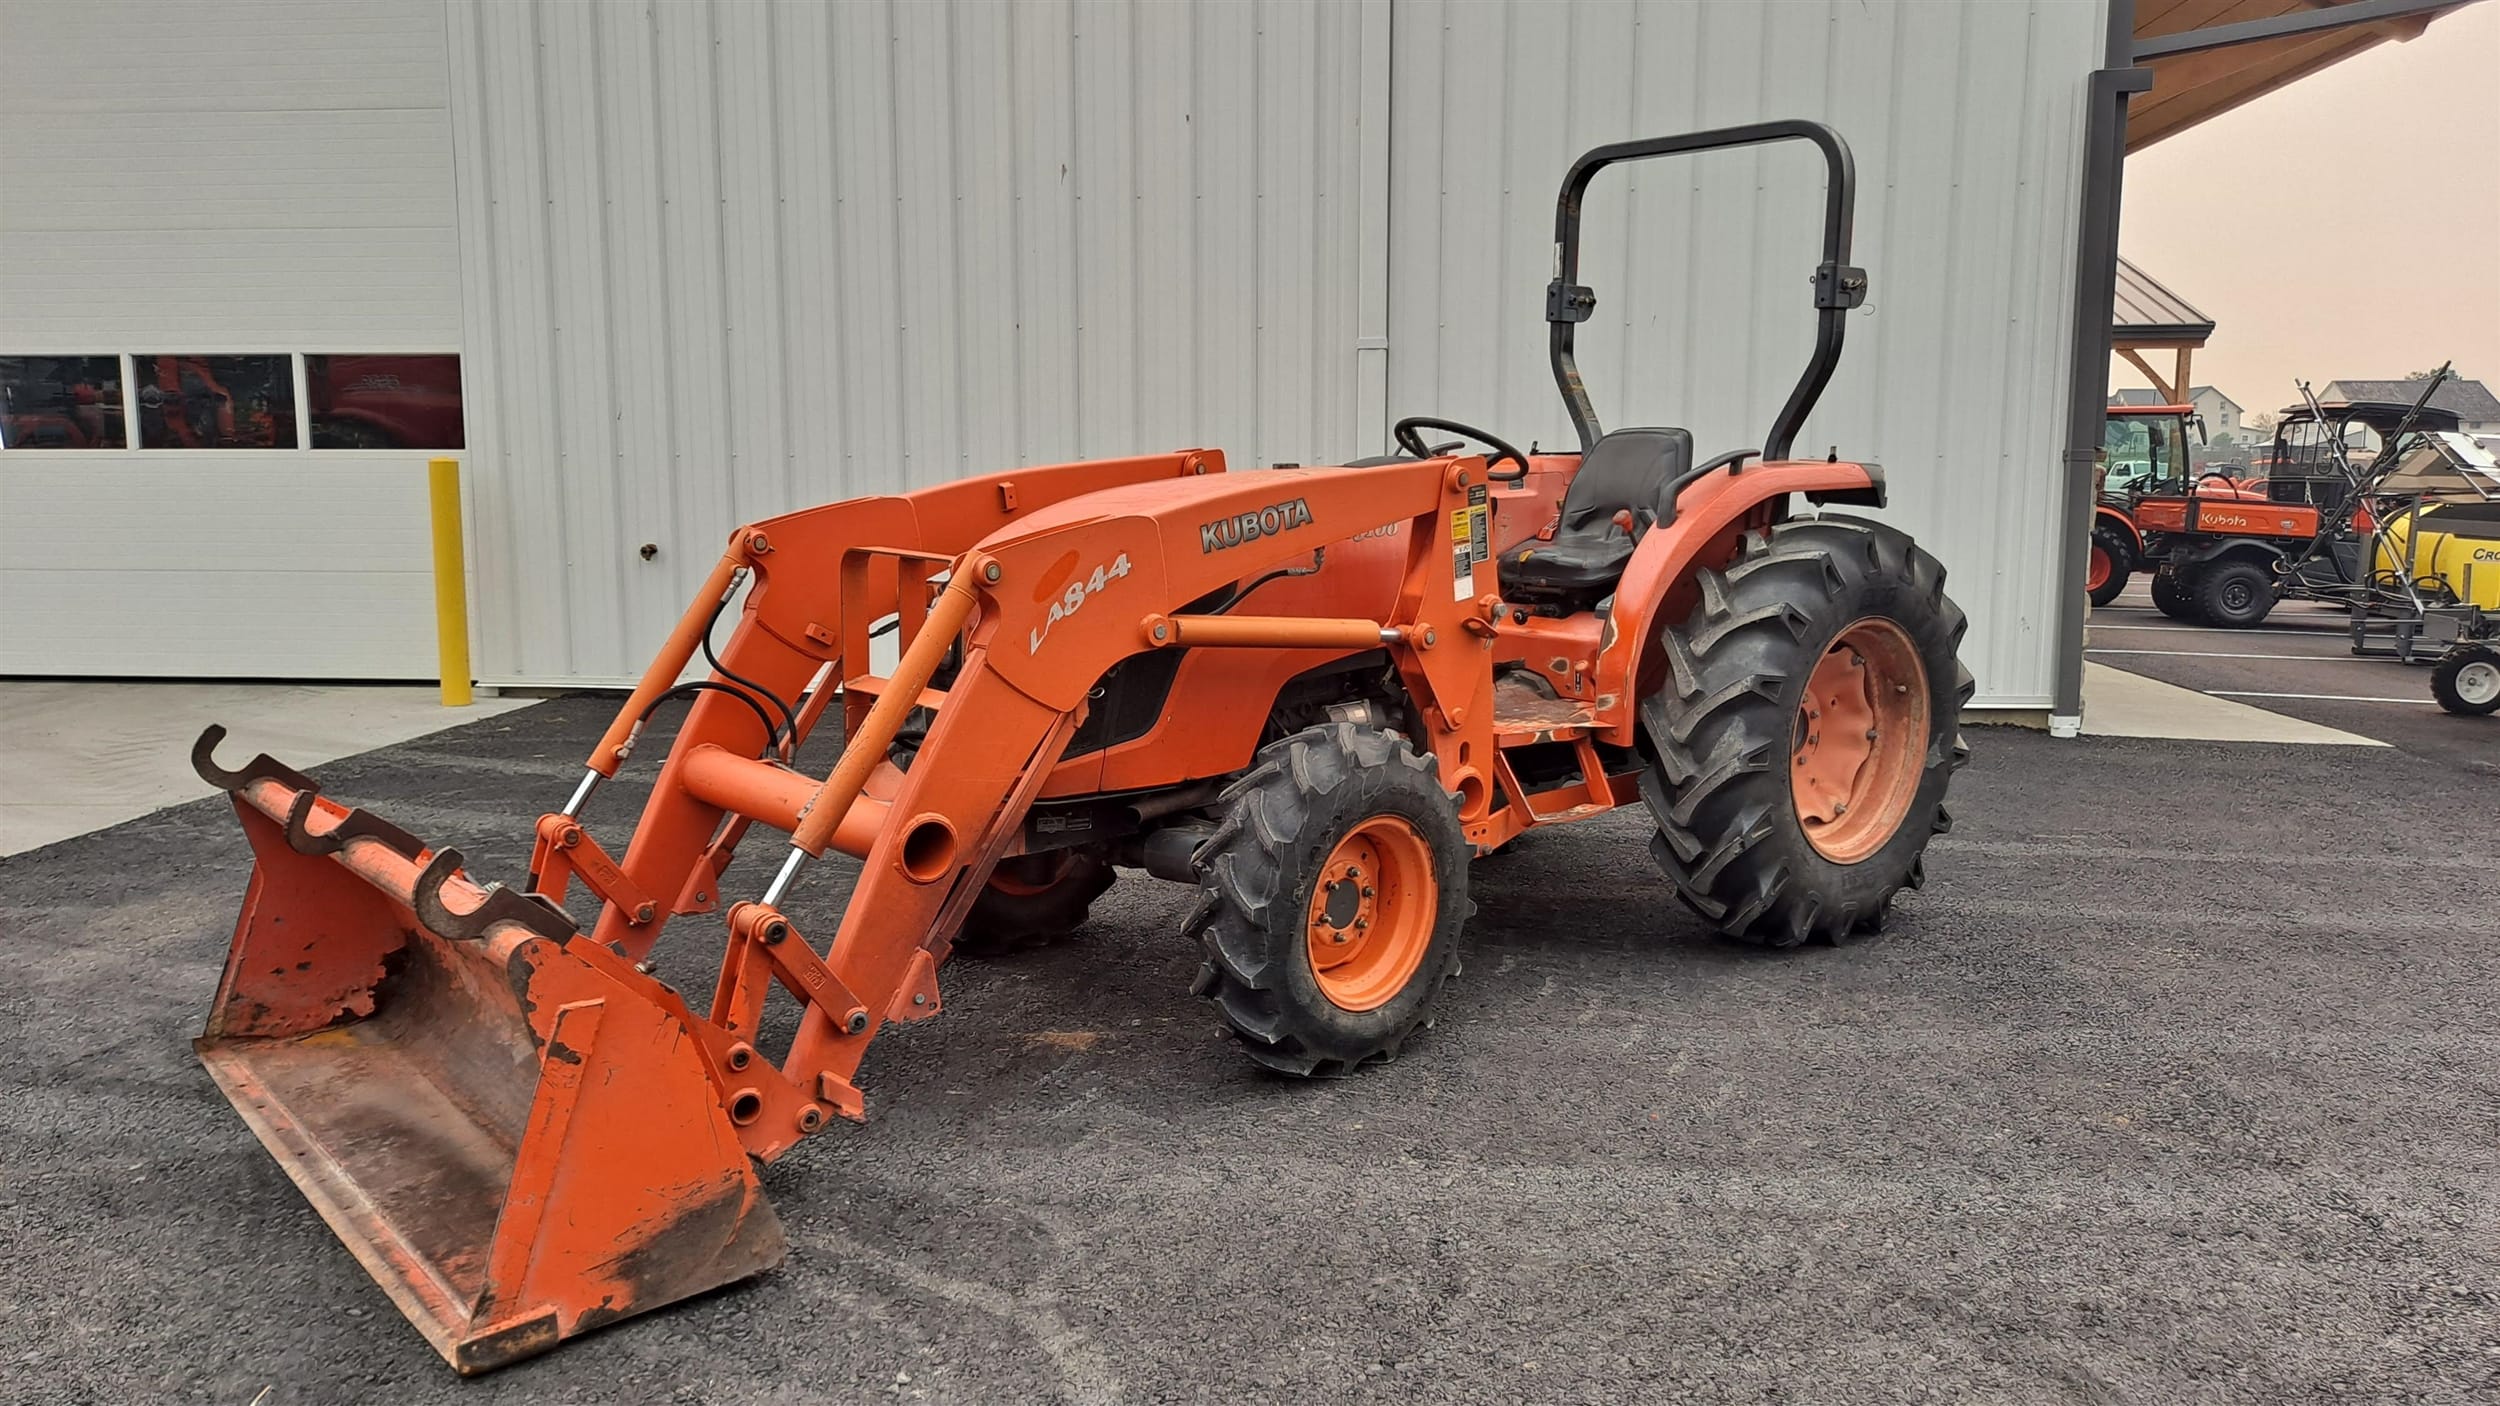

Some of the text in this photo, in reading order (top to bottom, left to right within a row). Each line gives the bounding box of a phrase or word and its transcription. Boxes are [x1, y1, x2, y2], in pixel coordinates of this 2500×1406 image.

[1200, 497, 1313, 553] KUBOTA
[2201, 513, 2247, 527] Kubota
[1030, 552, 1132, 657] LA844
